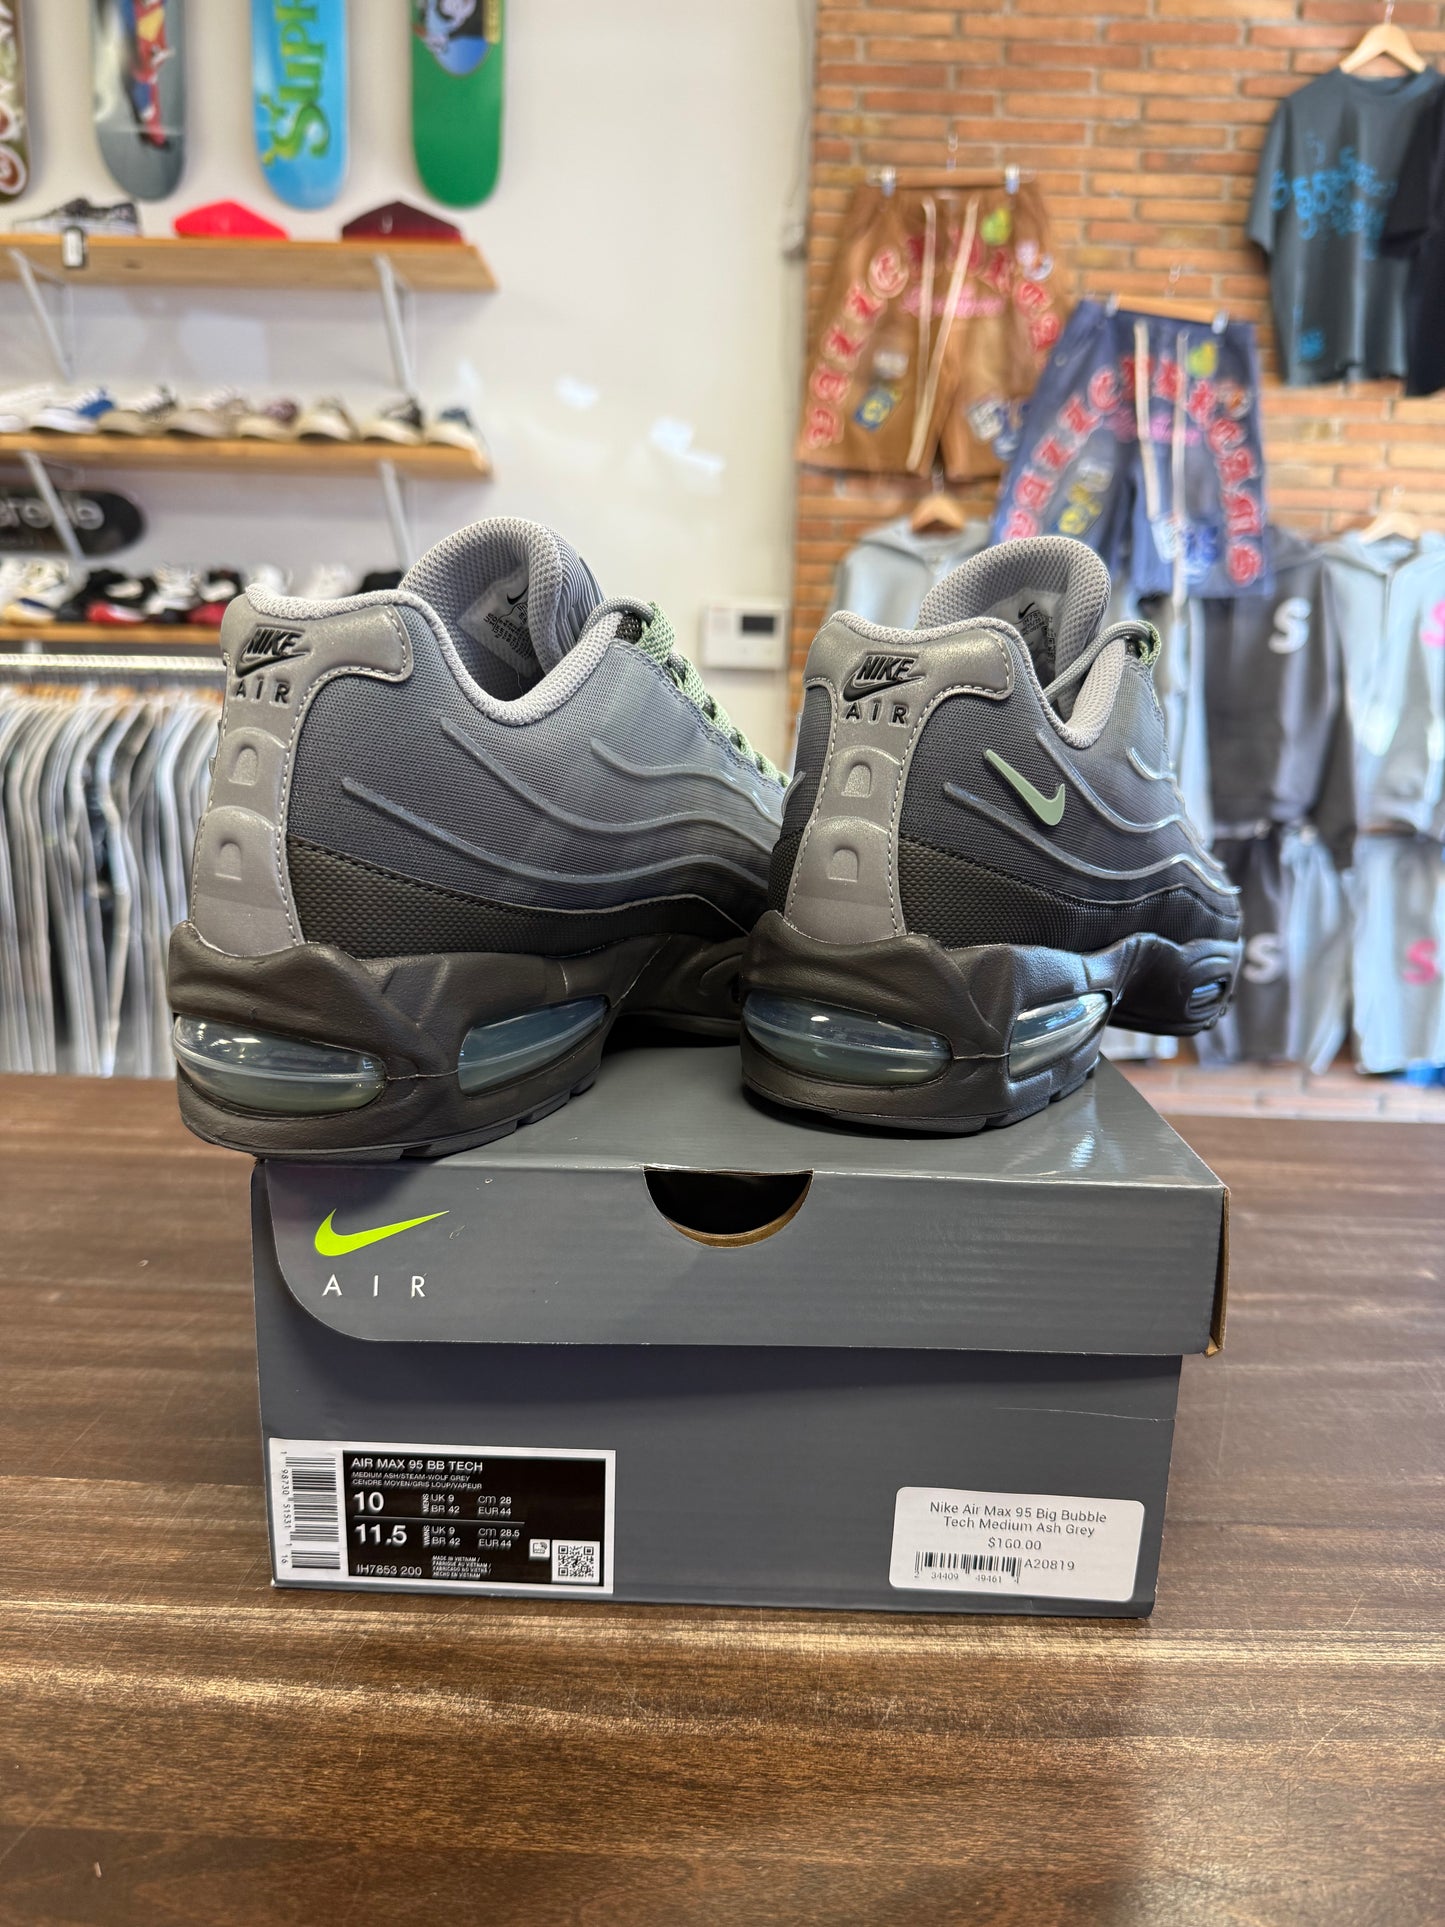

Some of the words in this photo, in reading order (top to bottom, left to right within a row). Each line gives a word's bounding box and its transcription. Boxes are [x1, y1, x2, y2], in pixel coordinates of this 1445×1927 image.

[1269, 597, 1311, 654] S
[244, 628, 303, 656] NIKE
[856, 656, 915, 681] NIKE
[236, 679, 291, 704] AIR
[846, 702, 907, 724] AIR
[1243, 933, 1284, 984] S
[1405, 938, 1437, 985] S
[322, 1273, 427, 1298] AIR
[352, 1458, 373, 1468] AIR
[377, 1458, 405, 1468] MAX
[409, 1460, 424, 1470] 95
[427, 1460, 444, 1470] BB
[448, 1460, 483, 1472] TECH
[431, 1482, 482, 1490] LOUP/VAPEUR
[354, 1491, 384, 1512] 10
[430, 1494, 446, 1502] UK
[448, 1494, 454, 1502] 9
[500, 1496, 512, 1504] 28
[431, 1504, 446, 1513] BR
[448, 1506, 460, 1514] 42
[478, 1506, 499, 1515] EUR
[500, 1508, 512, 1516] 44
[930, 1502, 958, 1514] Nike
[962, 1504, 979, 1515] Air
[984, 1505, 1011, 1517] Max
[1016, 1507, 1032, 1518] 95
[1036, 1508, 1056, 1522] Big
[1062, 1510, 1107, 1523] Bubble
[355, 1524, 408, 1544] 11.5
[431, 1526, 446, 1534] UK
[448, 1526, 456, 1534] 9
[500, 1528, 520, 1537] 28.5
[944, 1516, 974, 1528] Tech
[979, 1518, 1032, 1532] Medium
[1036, 1522, 1061, 1534] Ash
[1066, 1524, 1096, 1538] Grey
[432, 1536, 446, 1545] BR
[448, 1538, 461, 1546] 42
[478, 1538, 500, 1547] EUR
[500, 1540, 512, 1548] 44
[988, 1536, 1042, 1550] $160.00
[357, 1564, 398, 1574] IH7853
[400, 1566, 422, 1576] 200
[1024, 1558, 1075, 1570] A20819
[931, 1572, 959, 1581] 34409
